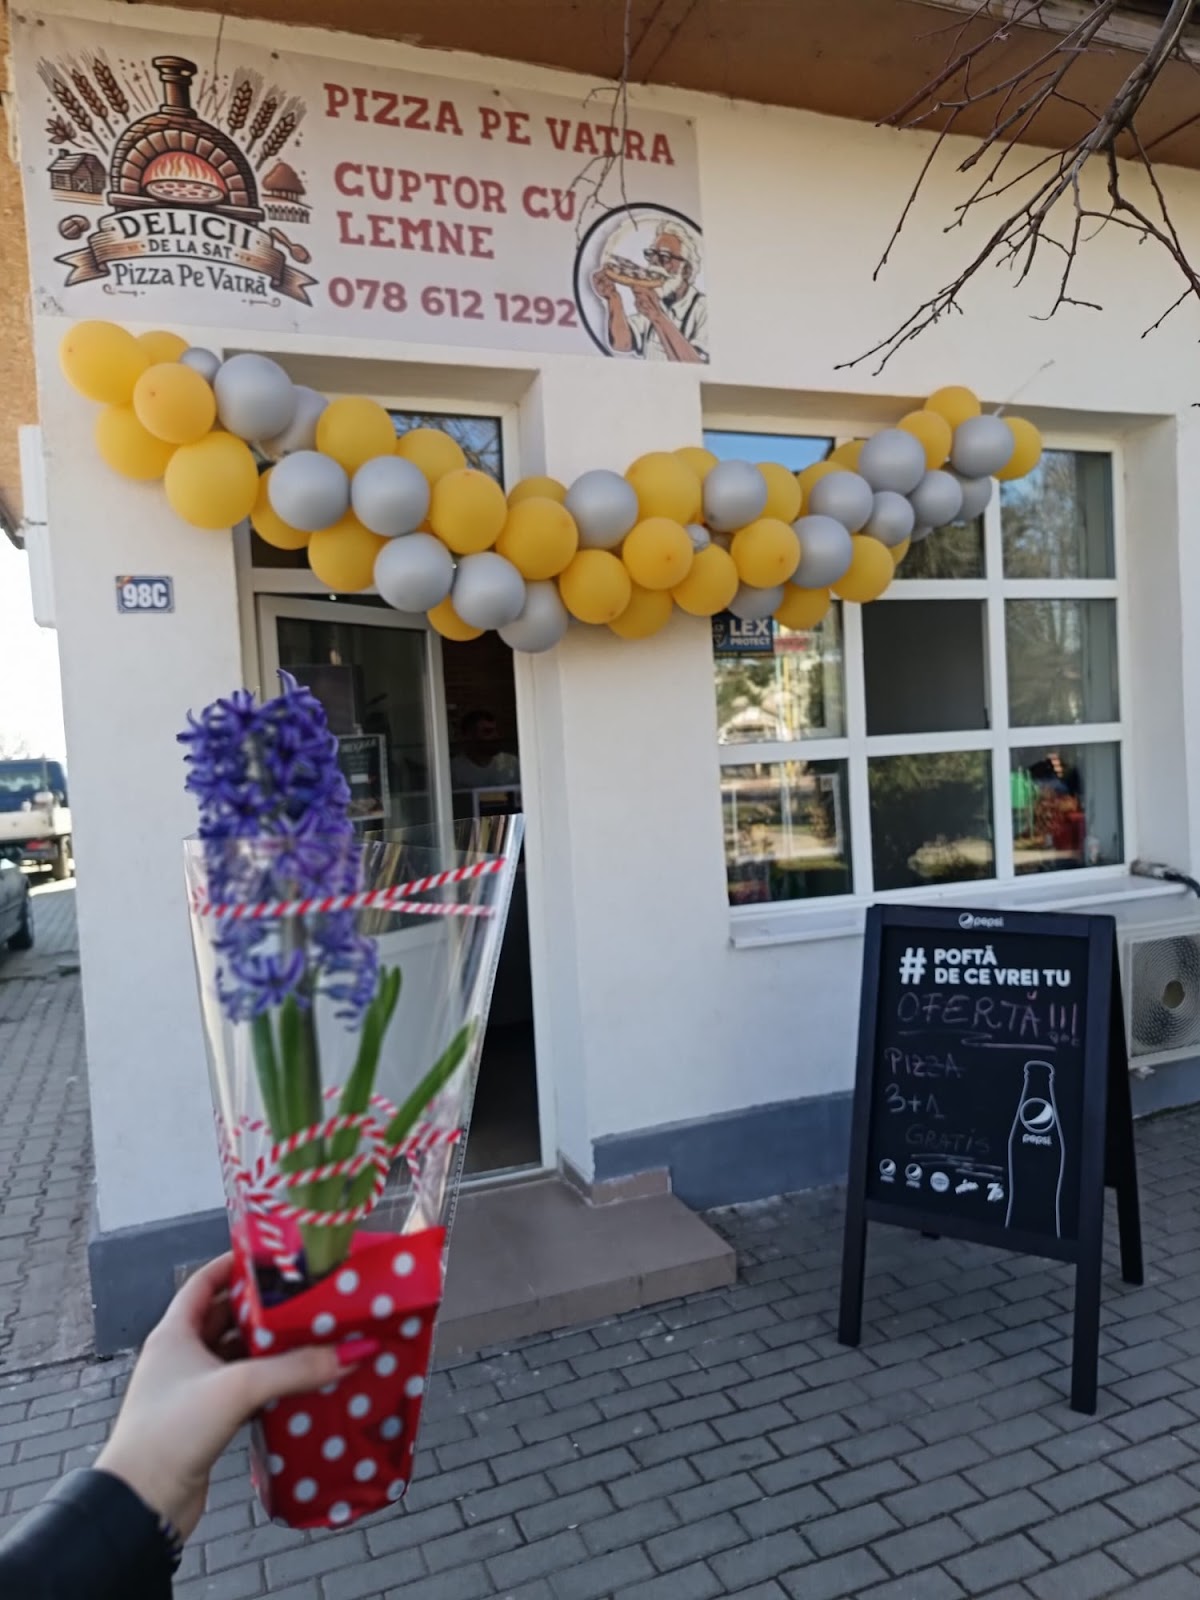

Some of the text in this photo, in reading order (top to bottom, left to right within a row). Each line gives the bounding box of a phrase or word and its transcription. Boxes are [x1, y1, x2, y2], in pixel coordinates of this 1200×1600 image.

[323, 83, 675, 165] PIZZA PE VATRA
[334, 162, 577, 221] CUPTOR CU
[114, 212, 252, 249] DELICII
[337, 211, 494, 259] LEMNE
[148, 239, 232, 259] DE LA SAT
[112, 263, 174, 286] Pizza
[177, 264, 205, 287] Pe
[328, 277, 578, 328] 078 612 1292
[122, 582, 168, 608] 98C
[729, 618, 769, 636] LEX
[730, 637, 771, 646] PROTECT
[935, 968, 1071, 987] DE CE VREI TU
